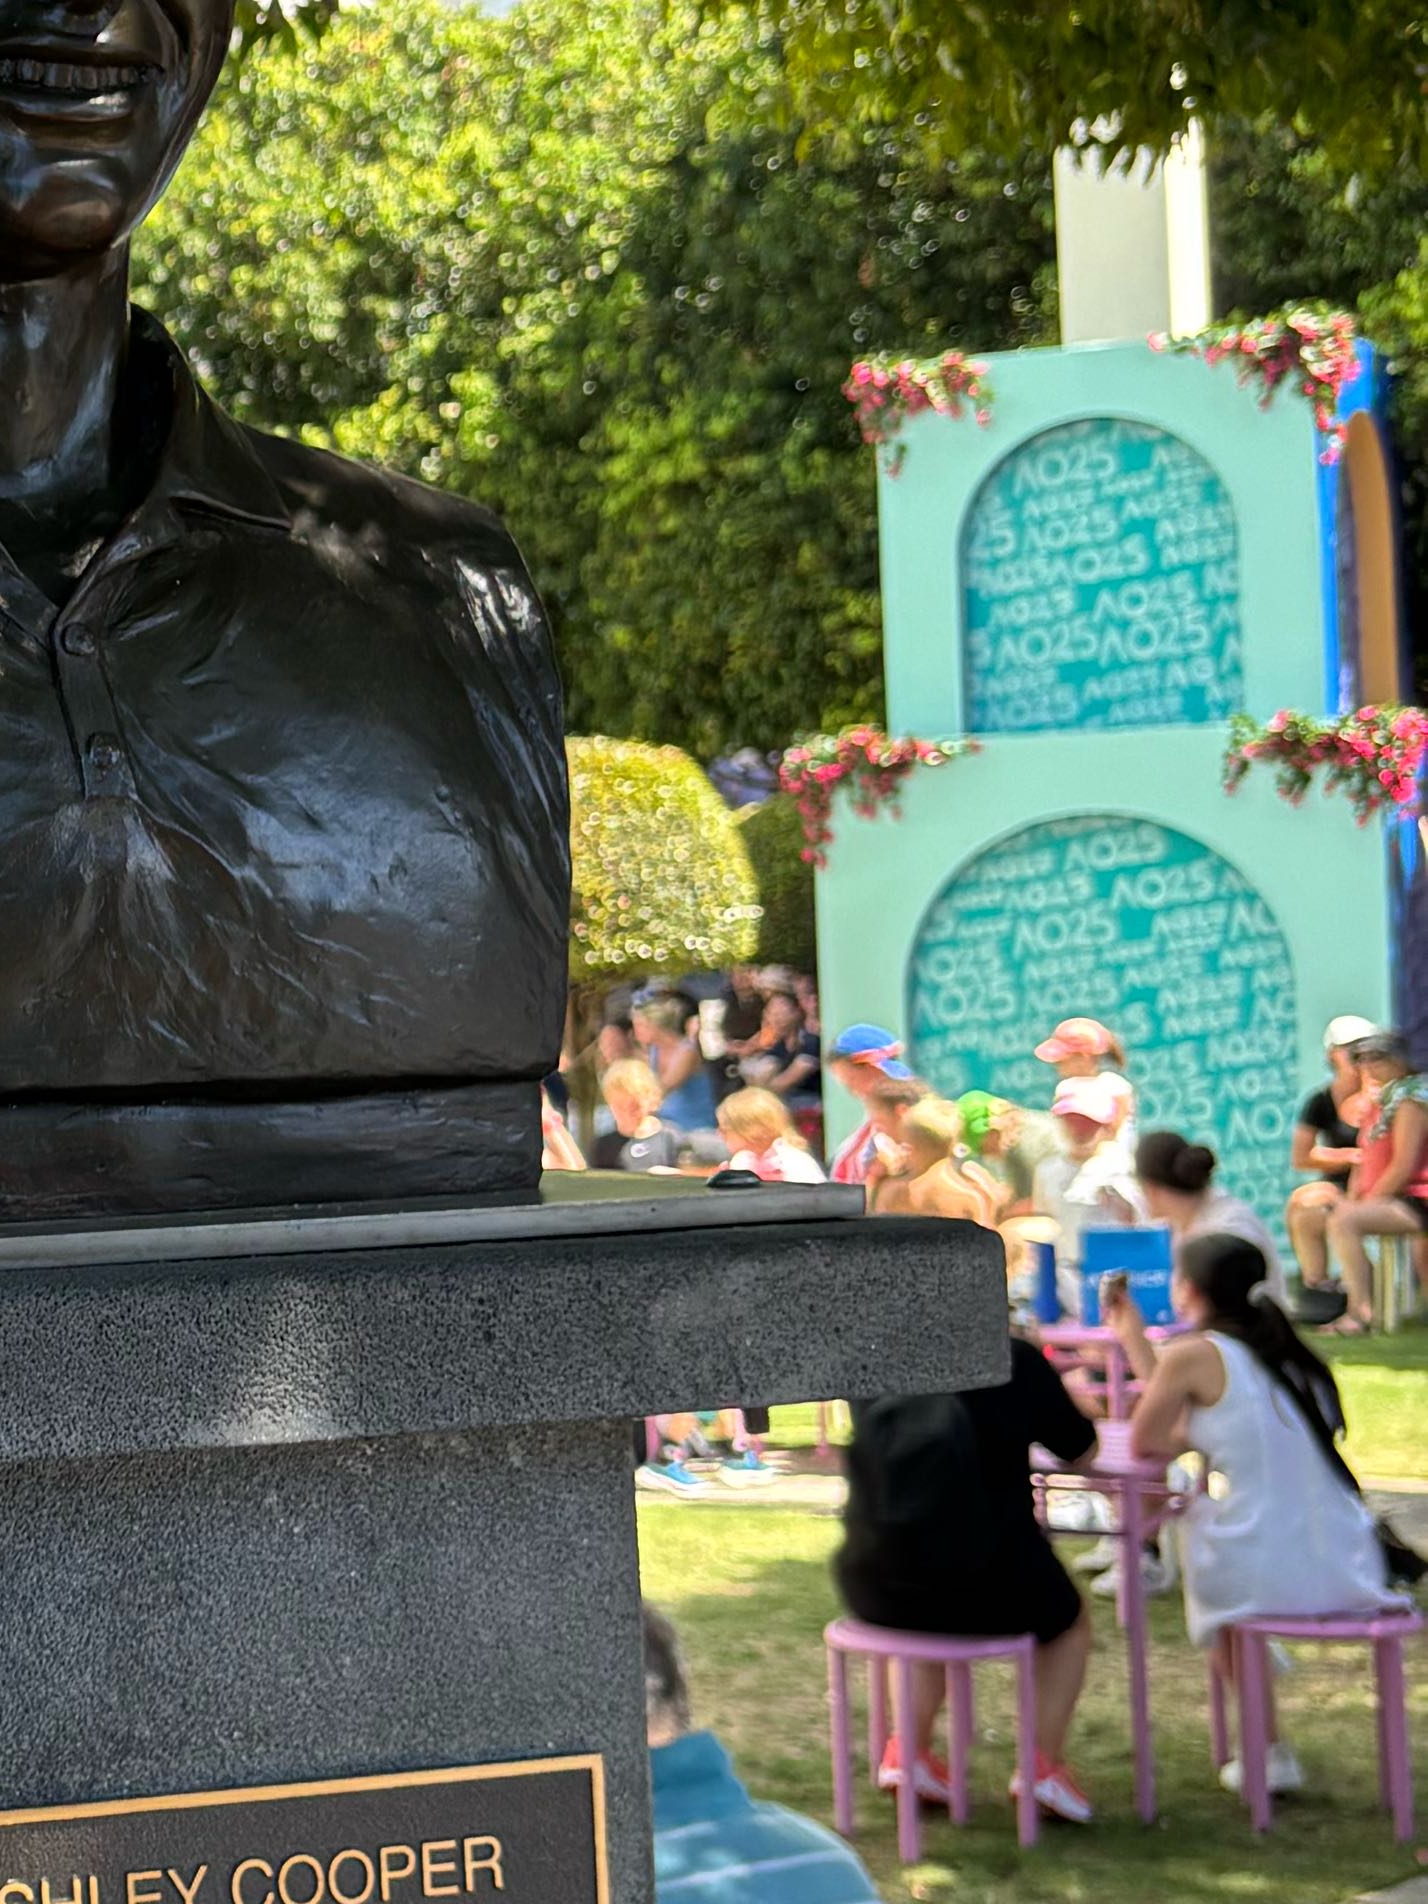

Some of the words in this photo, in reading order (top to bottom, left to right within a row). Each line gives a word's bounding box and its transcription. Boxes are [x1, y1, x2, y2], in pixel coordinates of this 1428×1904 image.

[1099, 605, 1209, 668] AO25
[1111, 858, 1214, 910] AO25
[1013, 902, 1116, 959] AO25
